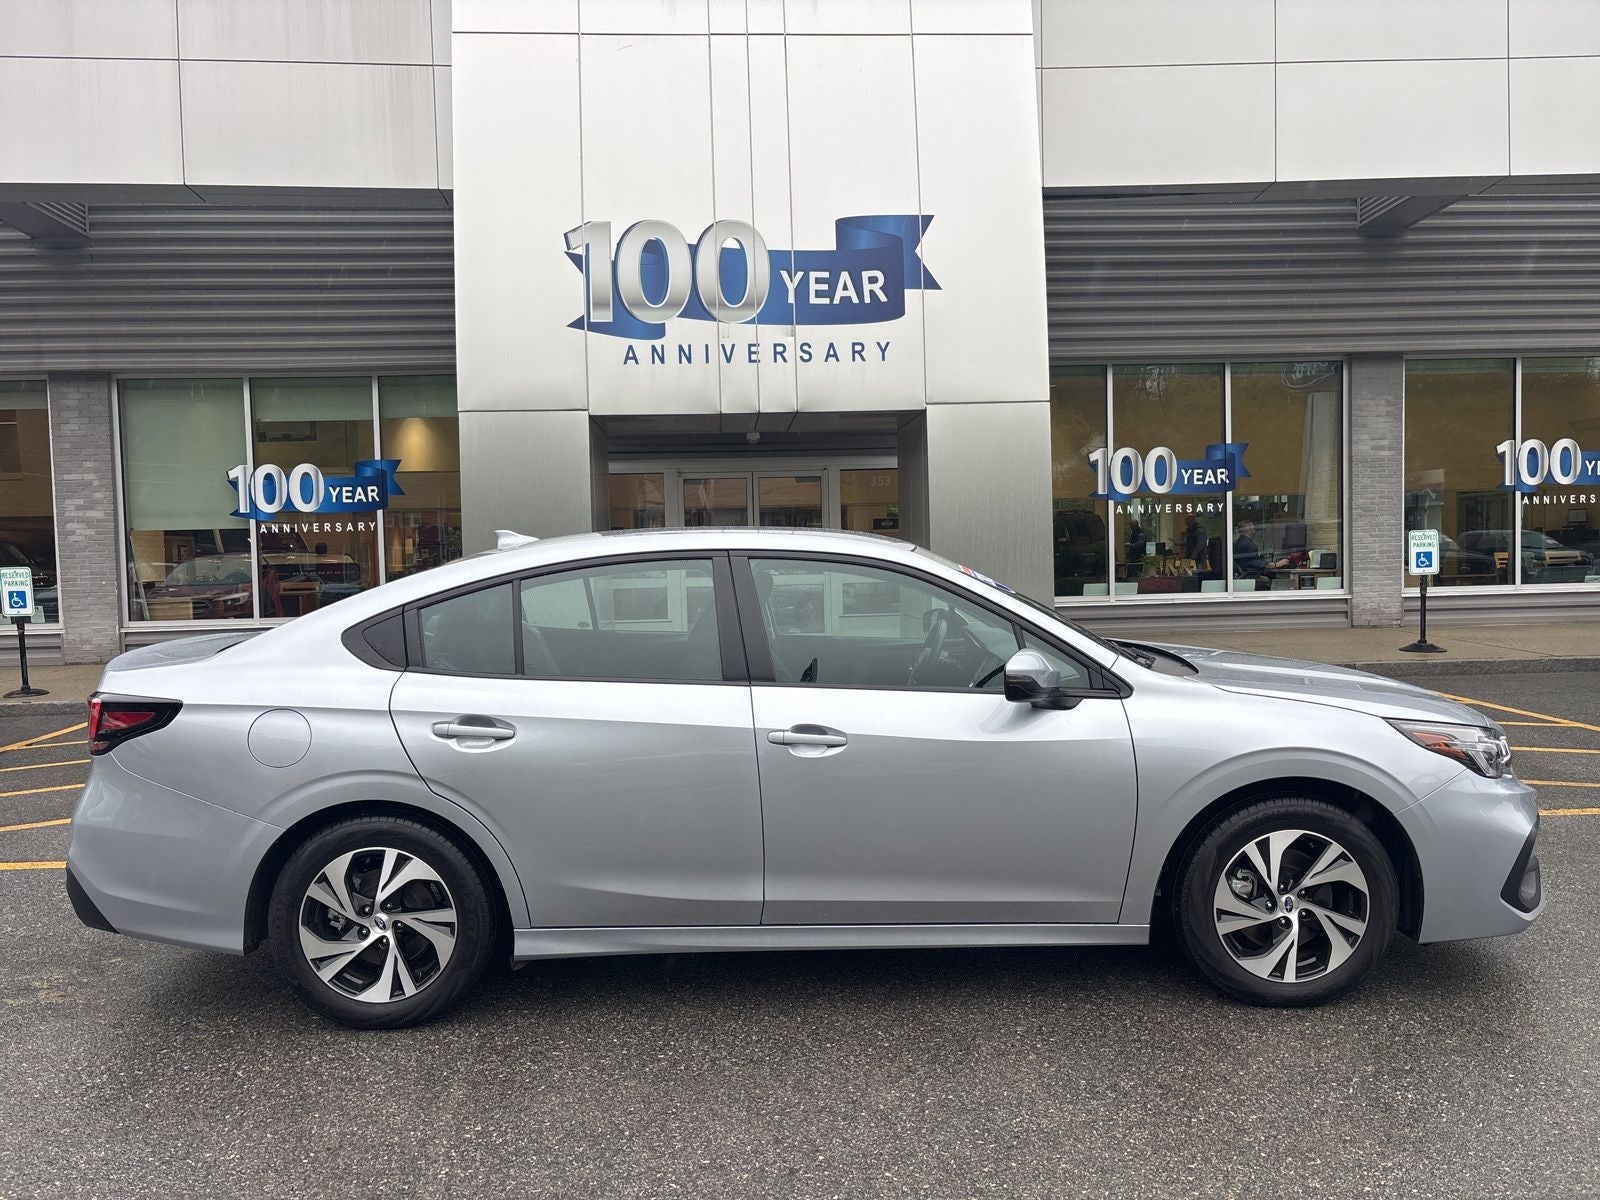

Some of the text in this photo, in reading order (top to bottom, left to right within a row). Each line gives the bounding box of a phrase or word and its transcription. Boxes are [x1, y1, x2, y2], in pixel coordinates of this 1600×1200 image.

[563, 219, 888, 324] 100 YEAR
[622, 341, 892, 365] ANNIVERSARY
[1088, 446, 1230, 495] 100 YEAR
[1494, 438, 1582, 486] 100
[226, 462, 380, 514] 100 YEAR
[1115, 502, 1225, 515] ANNIVERSARY
[259, 521, 376, 534] ANNIVERSARY
[2, 571, 29, 579] RESERVED
